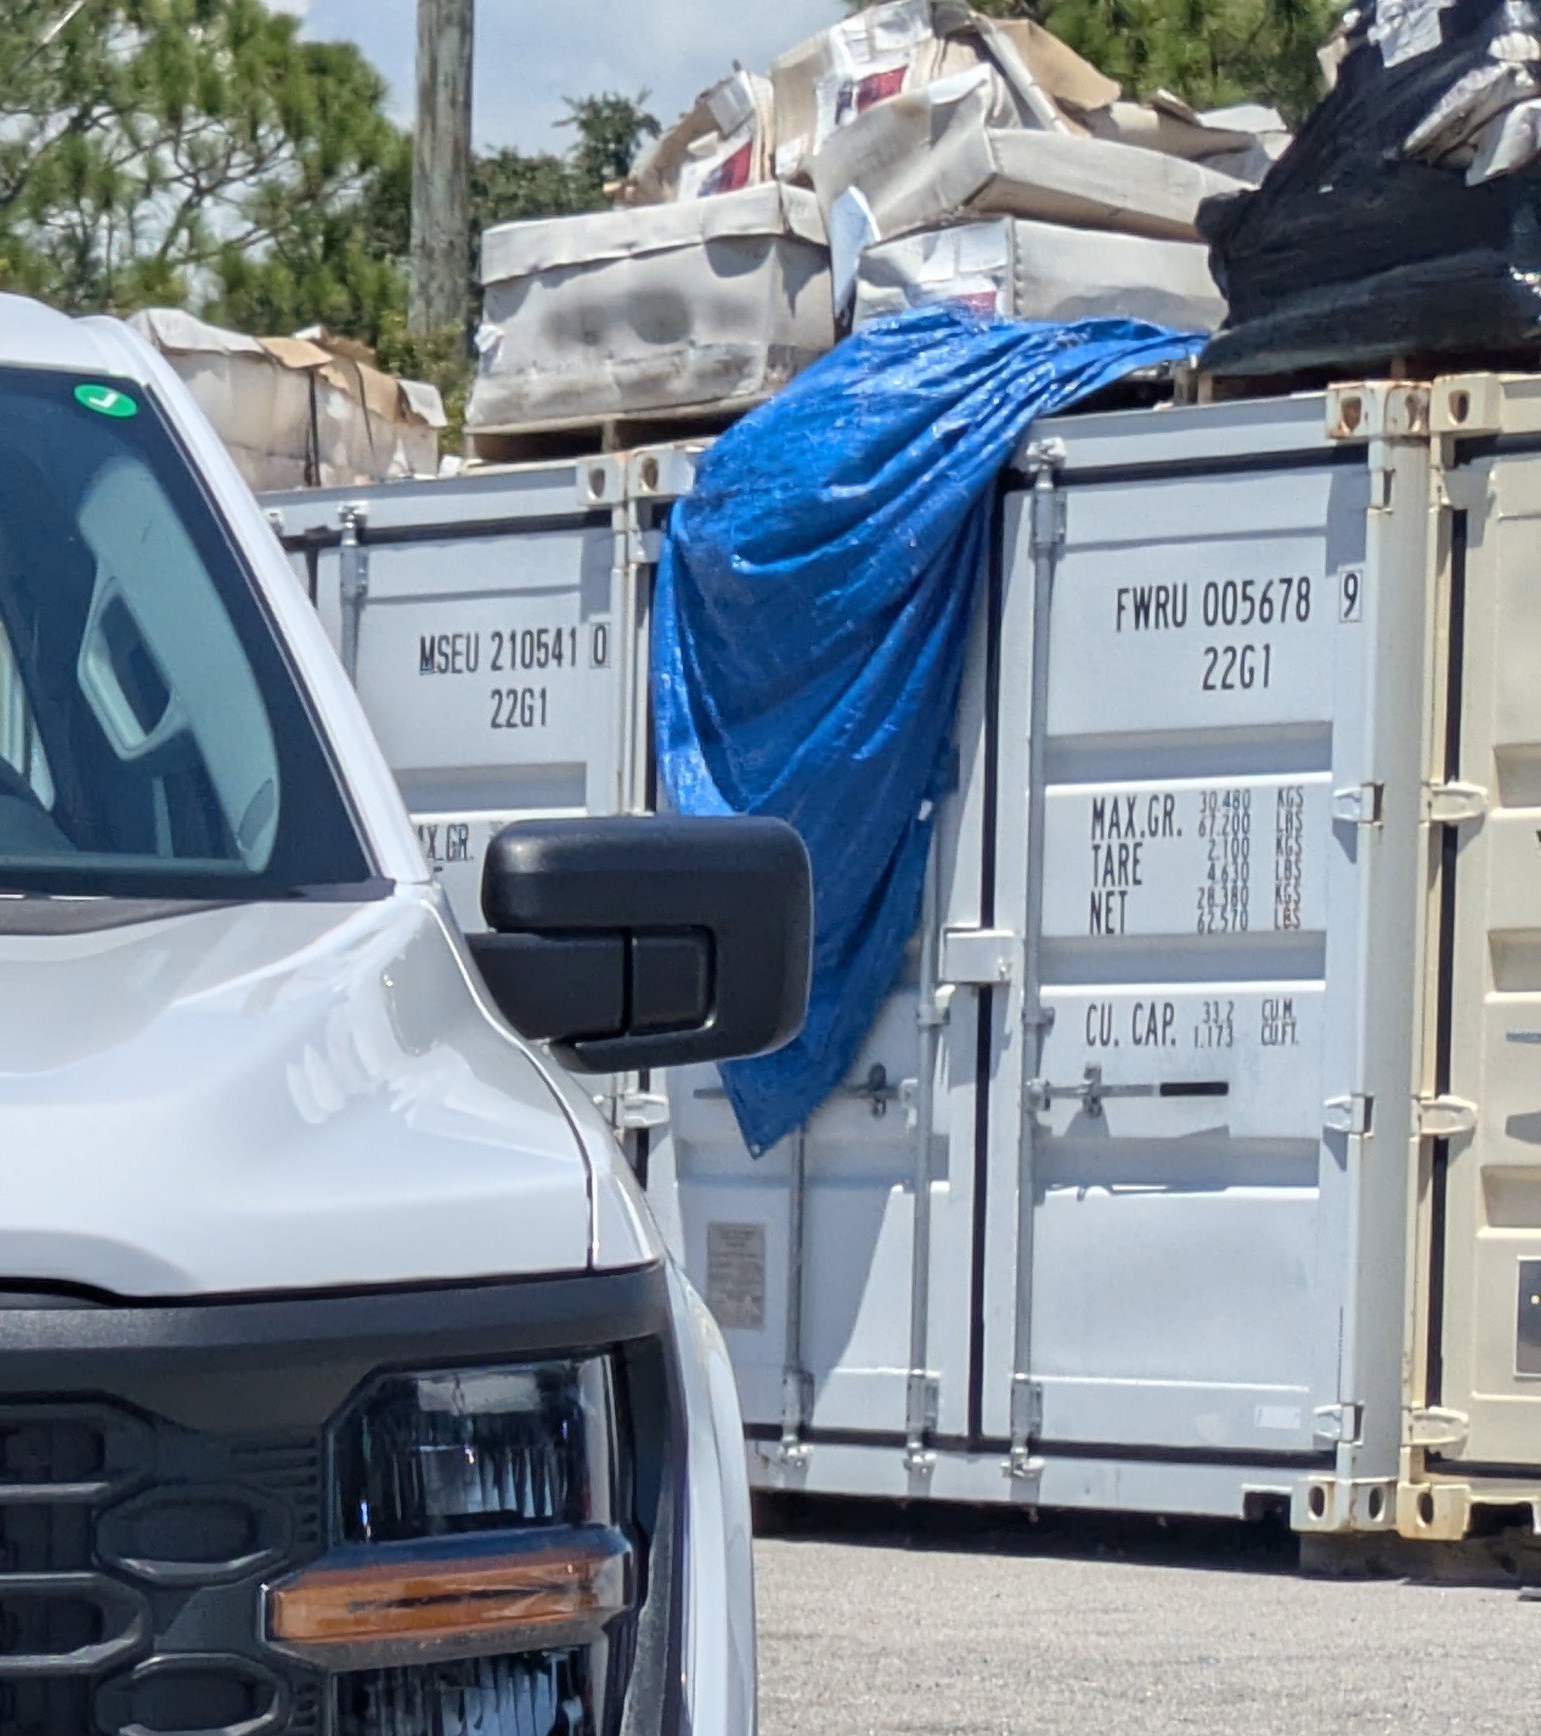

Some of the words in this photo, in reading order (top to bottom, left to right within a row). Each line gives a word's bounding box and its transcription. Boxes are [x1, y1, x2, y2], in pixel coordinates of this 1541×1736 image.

[1116, 582, 1187, 632] FWRU
[1203, 576, 1311, 626] 005678
[1341, 572, 1360, 620] 9
[419, 633, 480, 674] MSEU
[490, 626, 577, 671] 210541
[1202, 643, 1270, 690] 22G1
[490, 687, 548, 729] 22G1
[1092, 794, 1182, 840] MAX.GR.
[1277, 786, 1304, 808] KGS
[1092, 842, 1143, 887] TARE
[1090, 890, 1128, 935] NET
[1086, 1003, 1120, 1047] CU.
[1131, 1002, 1177, 1046] CAP.
